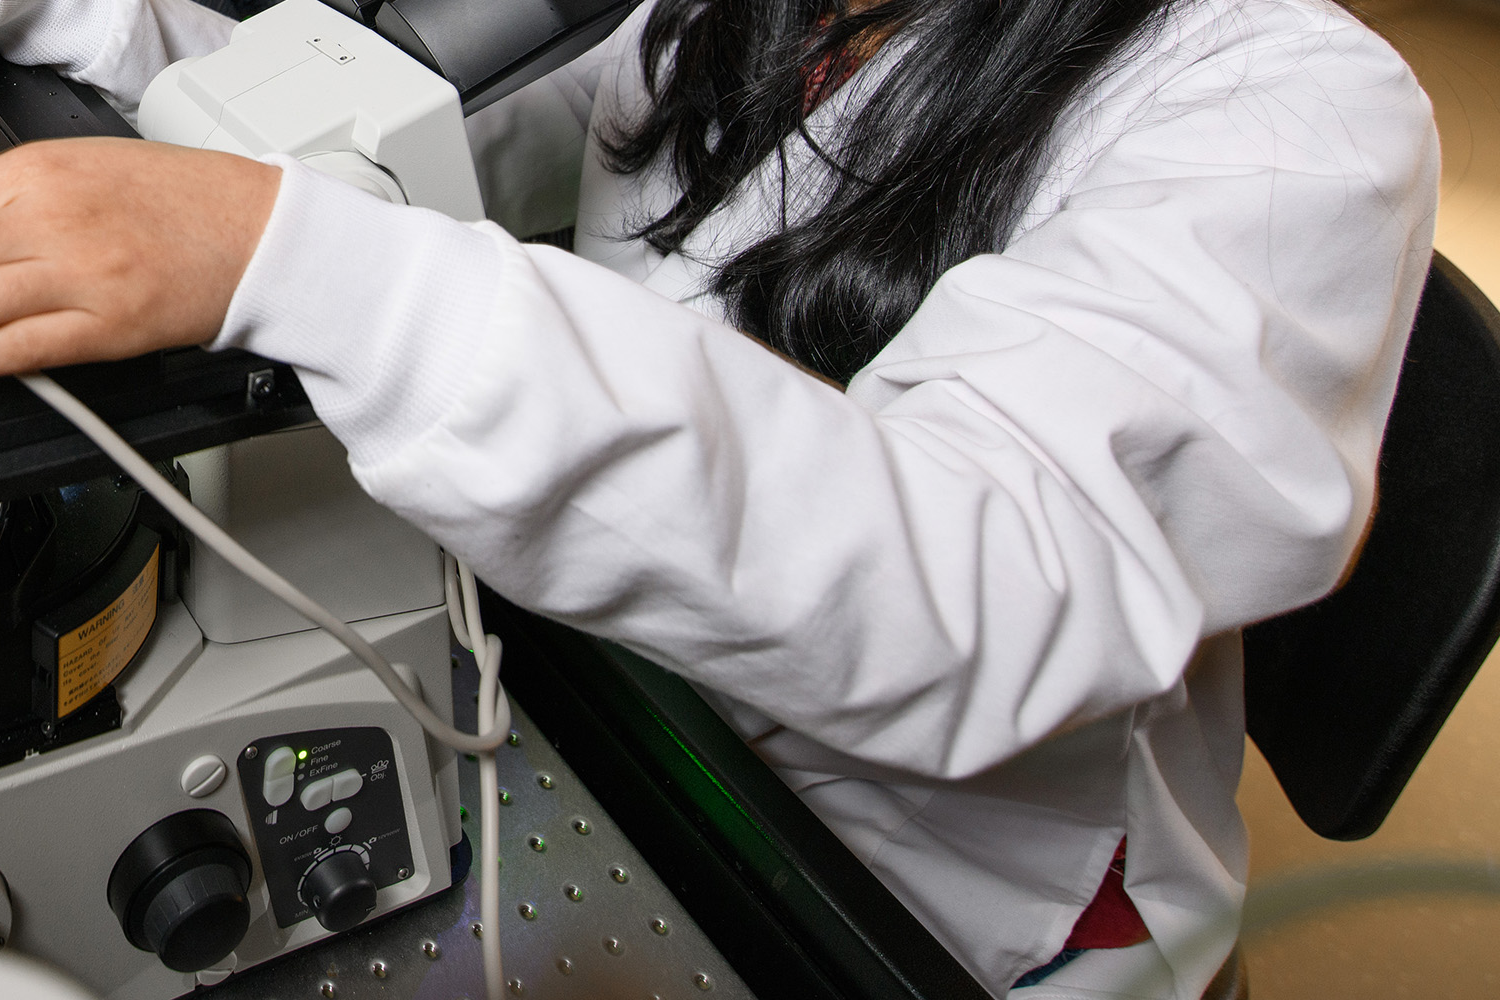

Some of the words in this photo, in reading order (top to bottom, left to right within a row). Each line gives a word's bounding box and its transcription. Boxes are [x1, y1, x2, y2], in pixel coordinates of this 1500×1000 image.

[78, 599, 125, 640] WARNING
[63, 647, 93, 669] HAZARD
[311, 739, 342, 755] Coarse
[310, 753, 329, 766] Fine
[309, 762, 339, 777] ExFine
[370, 771, 387, 782] Obj.
[279, 824, 318, 845] ON/OFF
